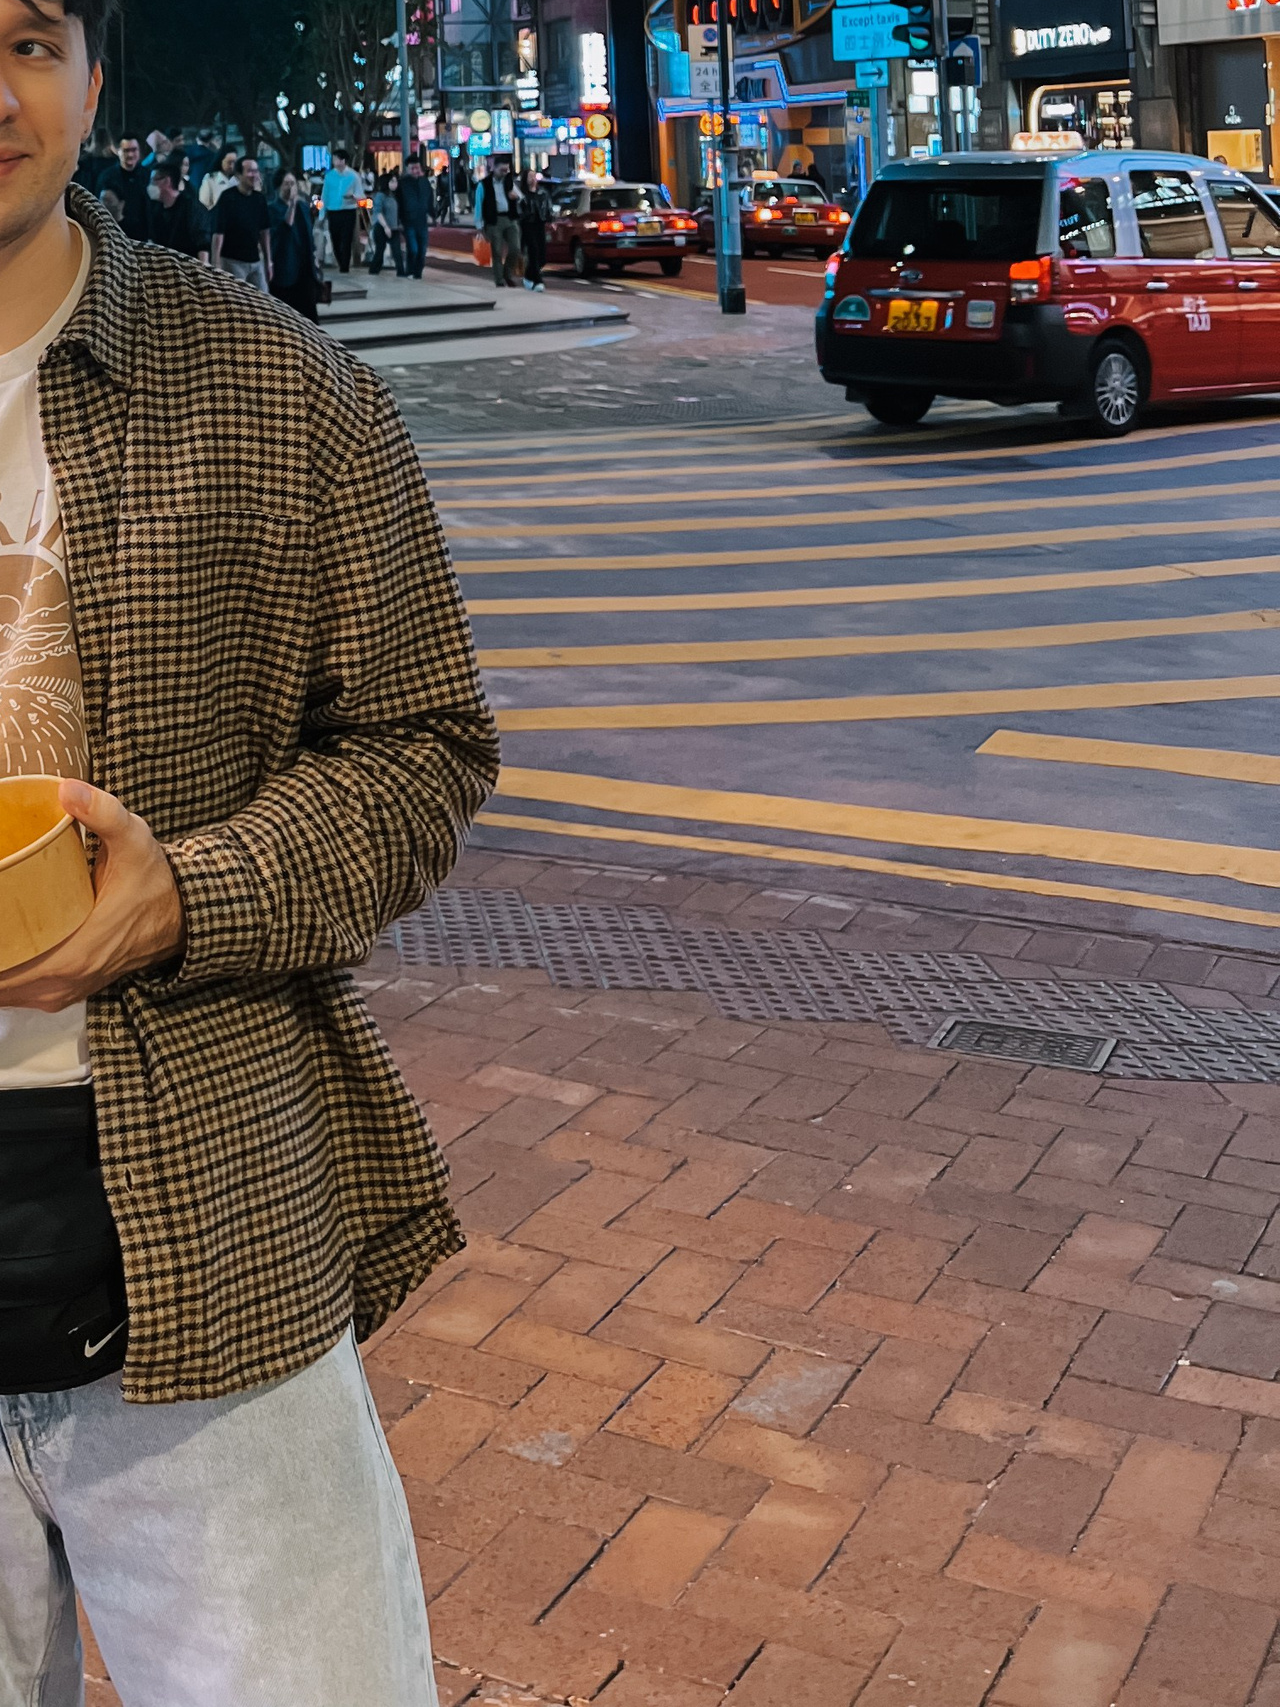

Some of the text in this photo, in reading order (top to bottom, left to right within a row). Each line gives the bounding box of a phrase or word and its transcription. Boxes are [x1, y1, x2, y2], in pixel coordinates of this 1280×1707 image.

[842, 13, 900, 28] Except taxis
[1027, 27, 1057, 51] DUTY
[1057, 22, 1091, 48] ZERO
[1185, 313, 1211, 332] TAXI
